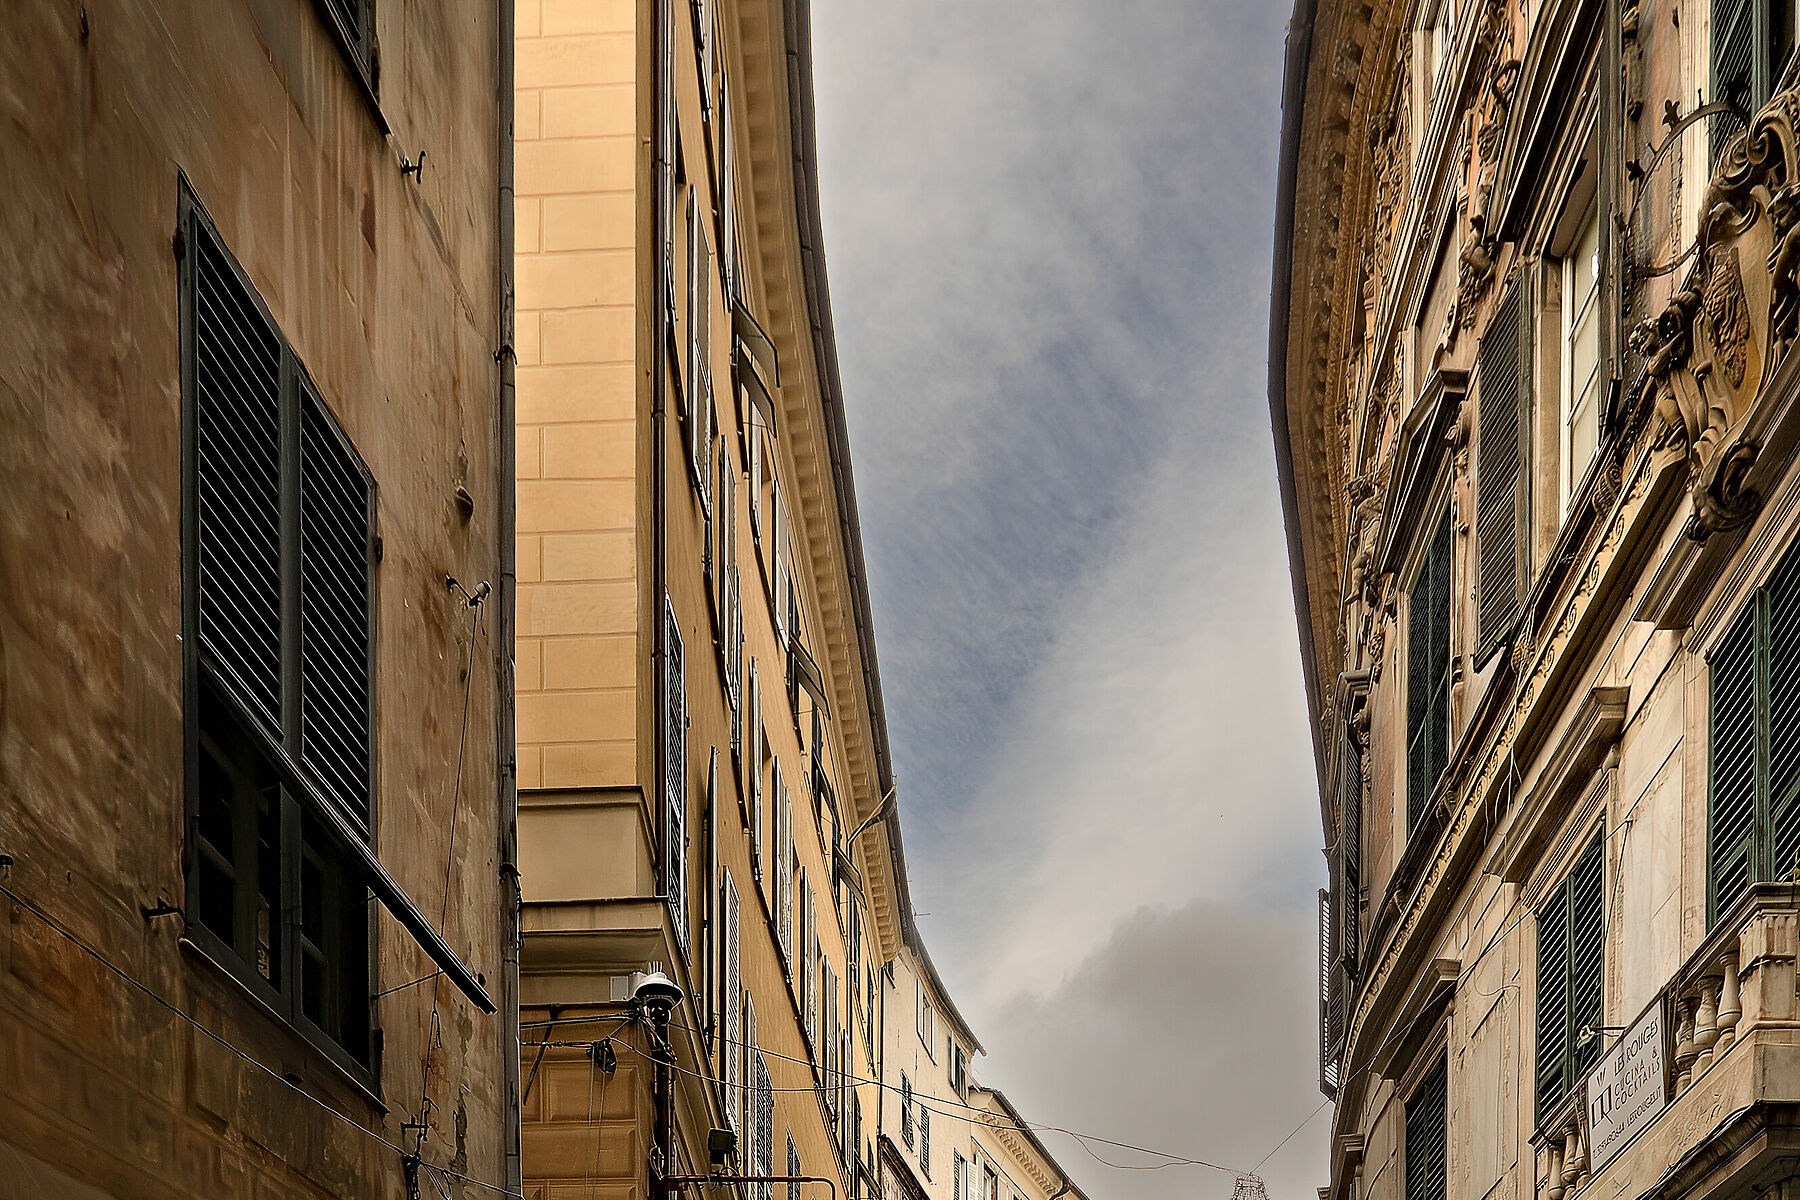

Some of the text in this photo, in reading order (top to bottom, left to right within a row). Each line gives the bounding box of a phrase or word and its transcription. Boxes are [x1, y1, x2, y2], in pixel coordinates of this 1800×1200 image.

[1614, 1017, 1659, 1077] LES ROUGES
[1614, 1059, 1645, 1096] CUCINA
[1614, 1057, 1661, 1111] COCKTAILS
